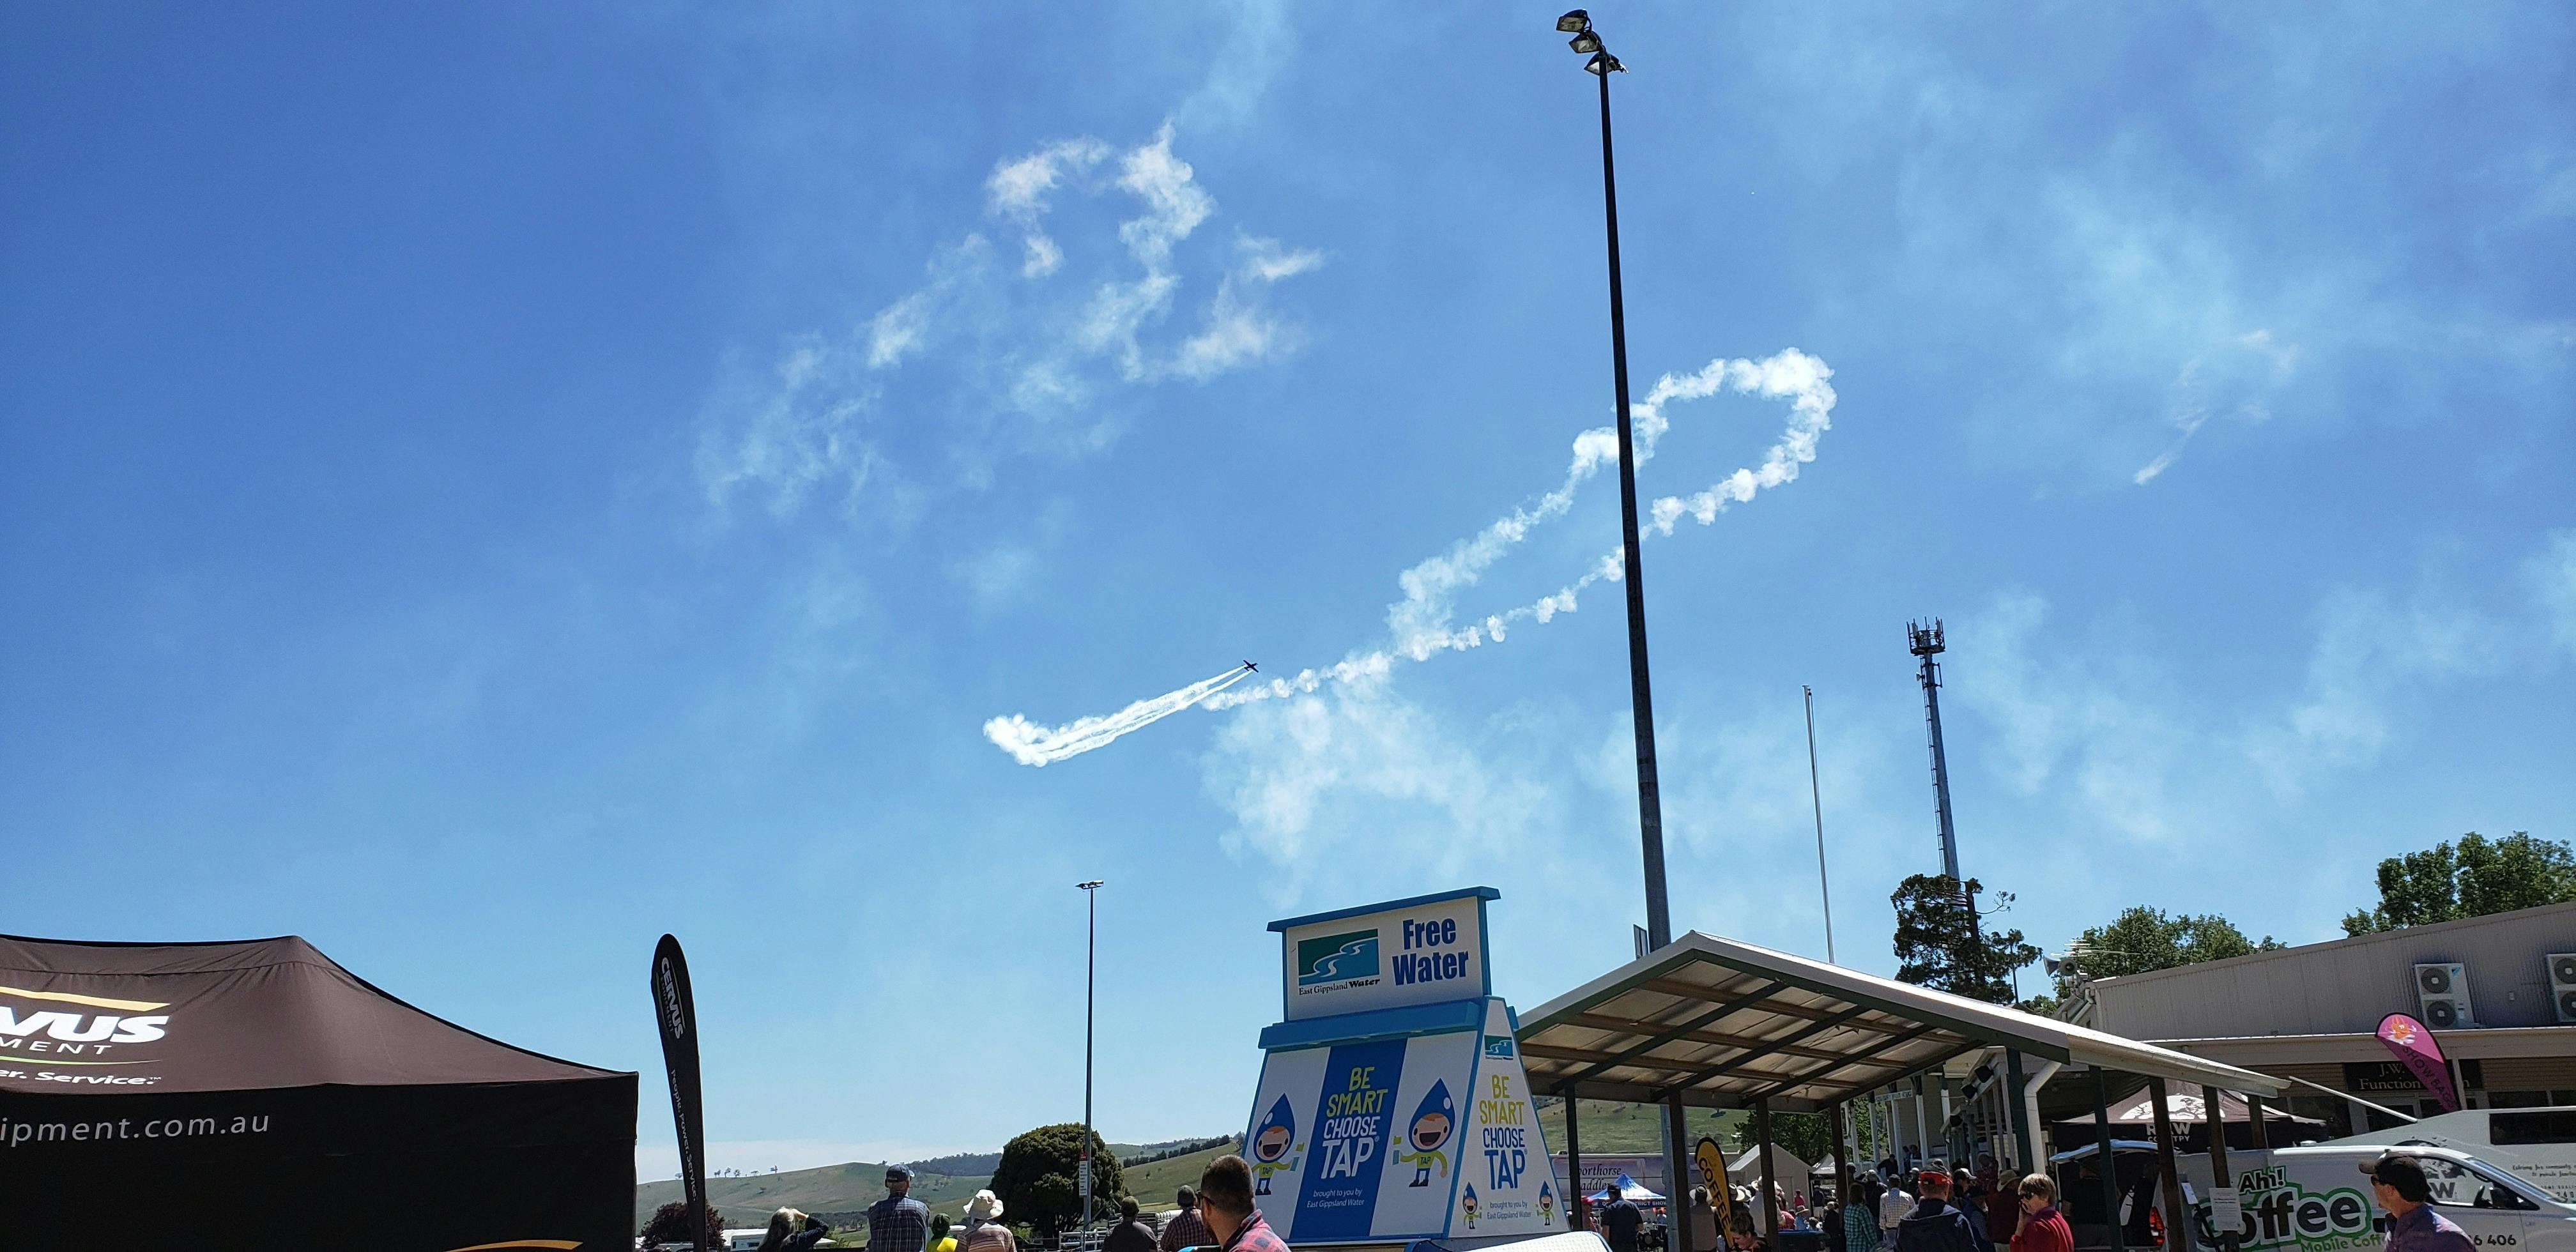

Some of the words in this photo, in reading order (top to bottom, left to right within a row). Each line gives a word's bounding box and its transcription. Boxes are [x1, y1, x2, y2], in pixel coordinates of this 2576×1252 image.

[1403, 918, 1456, 950] Free
[1392, 950, 1469, 986] Water
[661, 957, 684, 1039] CERVUS
[1314, 982, 1348, 994] Gippsland
[1348, 979, 1380, 988] Water
[2402, 1046, 2433, 1078] SHOW
[1349, 1067, 1375, 1091] BE
[1491, 1074, 1510, 1099] BE
[2359, 1077, 2421, 1090] Function
[1326, 1088, 1388, 1117] SMART
[1479, 1100, 1524, 1125] SMART
[0, 1114, 270, 1148] ipment.com.au
[1323, 1116, 1381, 1139] CHOOSE
[1483, 1127, 1526, 1149] CHOOSE
[2147, 1122, 2191, 1135] RW
[1420, 1157, 1430, 1165] TAP
[2239, 1167, 2285, 1193] Ah!
[1313, 1189, 1335, 1198] brought
[1354, 1187, 1363, 1196] by
[1319, 1199, 1347, 1209] Gippsland
[1699, 1157, 1731, 1229] COFFEE
[1490, 1202, 1507, 1210] brought
[1522, 1200, 1528, 1209] by
[2300, 1238, 2349, 1252] Mobile
[2351, 1234, 2383, 1248] Coff
[2487, 1234, 2517, 1246] 406
